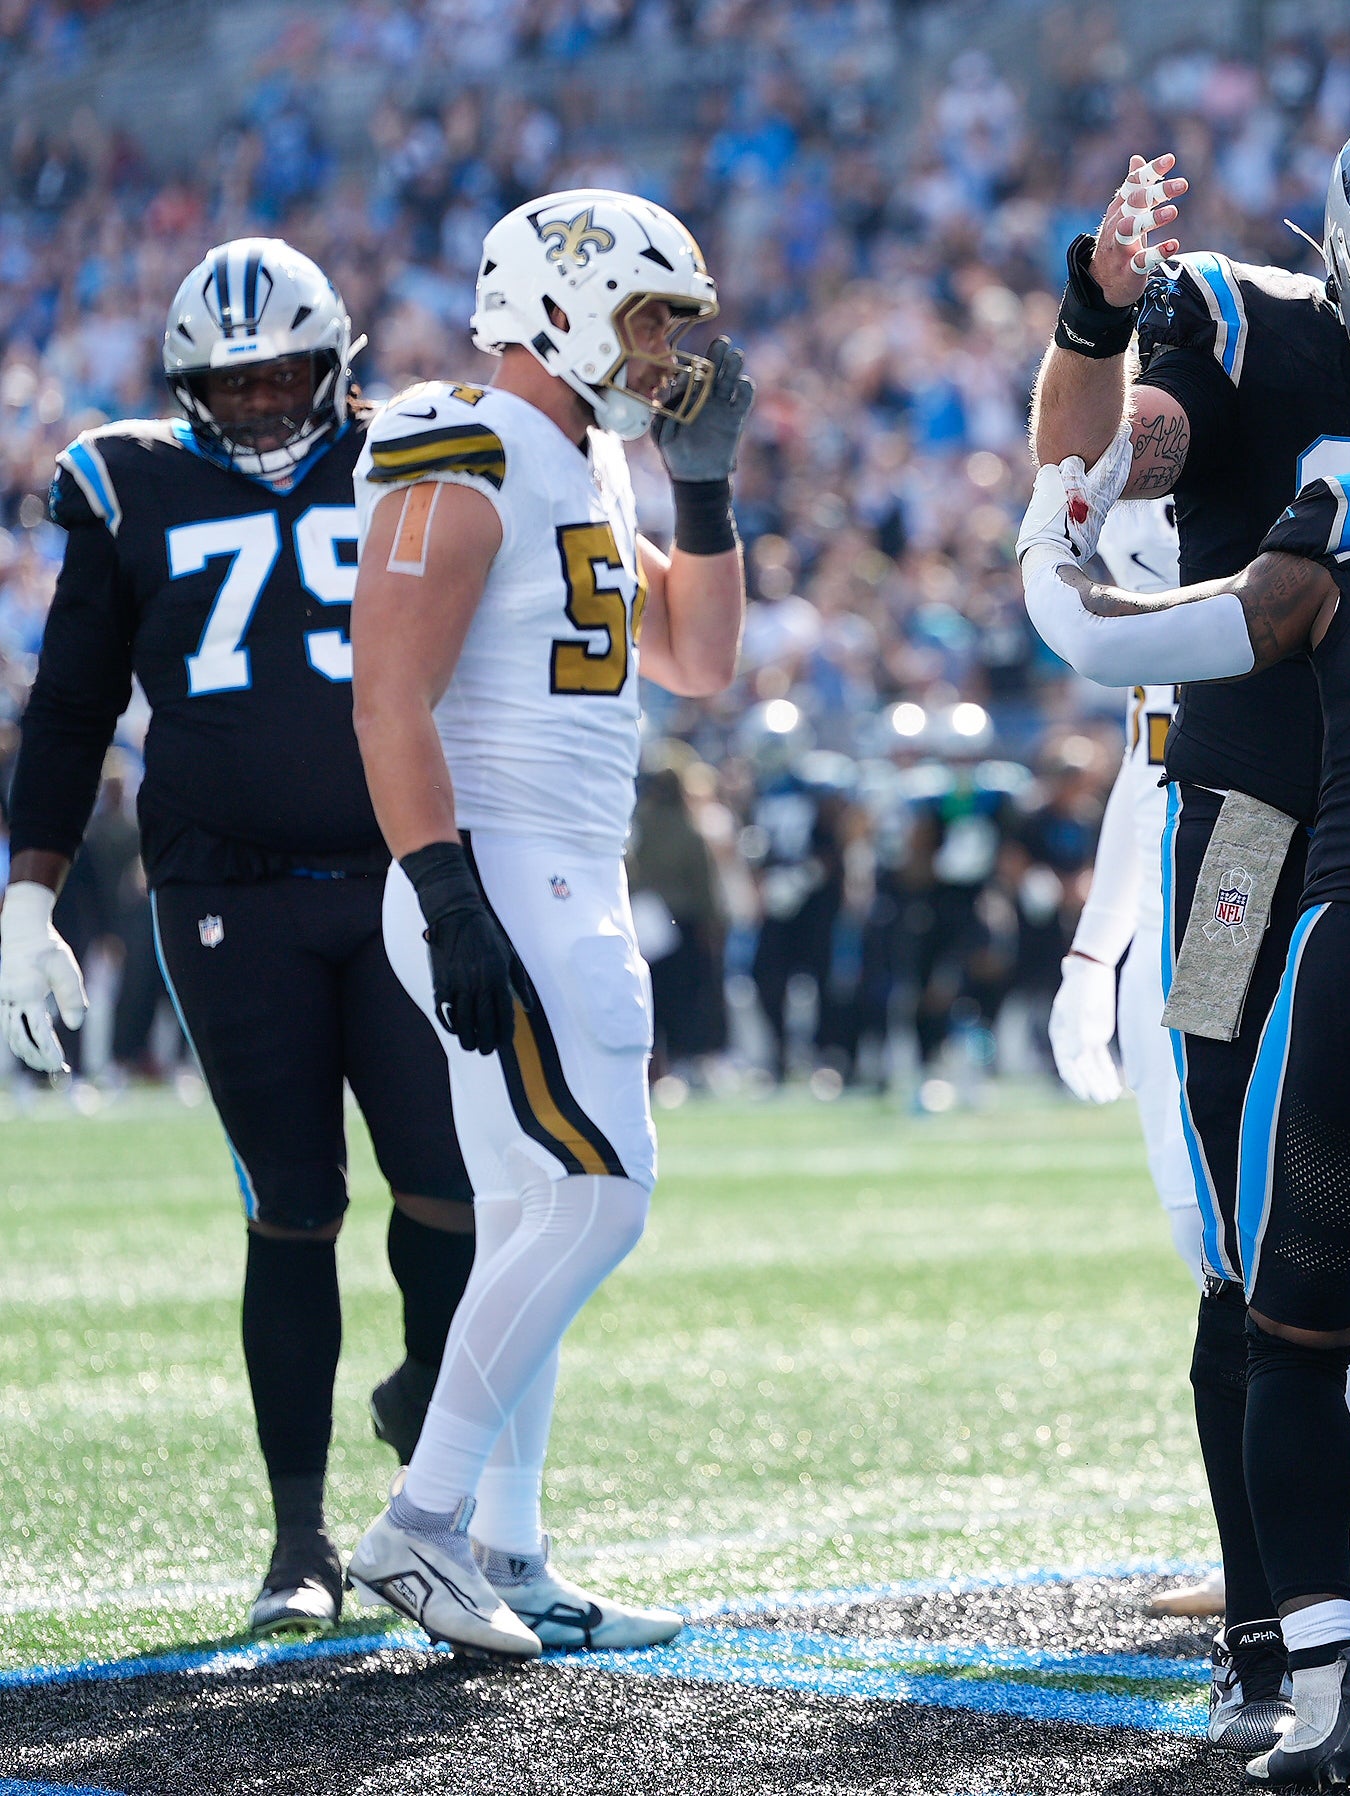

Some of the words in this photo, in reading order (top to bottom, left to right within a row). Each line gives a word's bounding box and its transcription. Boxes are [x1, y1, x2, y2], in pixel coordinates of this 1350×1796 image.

[165, 502, 357, 698] 79
[1217, 902, 1241, 923] NFL
[1239, 1630, 1280, 1646] ALPHA
